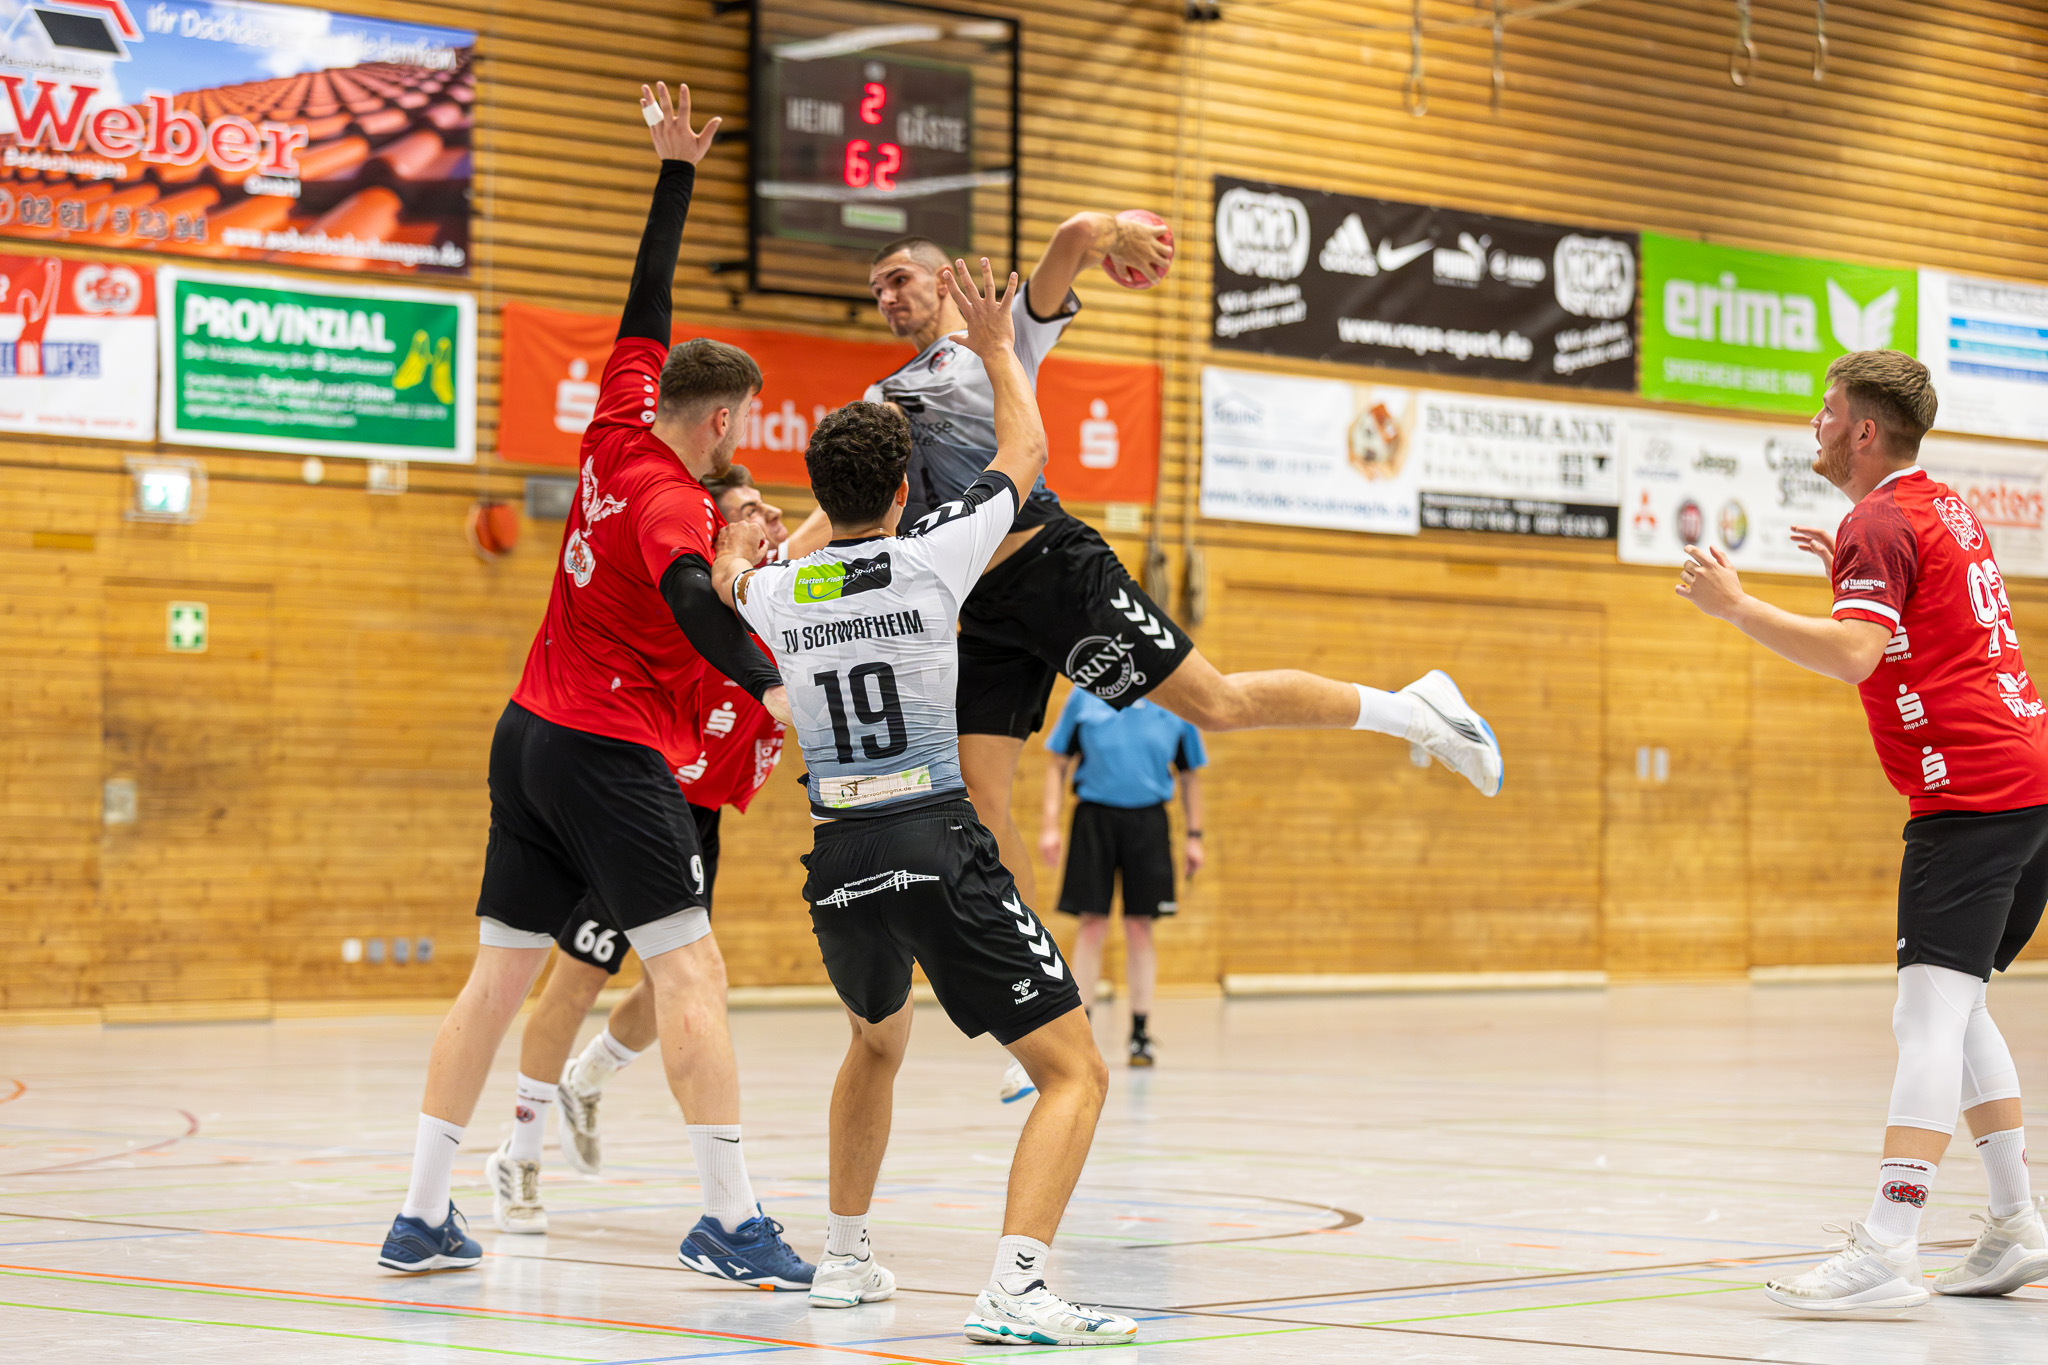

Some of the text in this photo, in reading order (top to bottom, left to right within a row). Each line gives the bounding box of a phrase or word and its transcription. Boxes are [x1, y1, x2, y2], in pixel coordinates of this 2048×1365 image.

[0, 75, 306, 176] Weber
[786, 97, 844, 136] HEIM
[860, 82, 886, 124] 2
[897, 105, 967, 152] GÄSTE
[844, 139, 901, 191] 62
[182, 293, 397, 353] PROVINZIAL
[1662, 271, 1822, 353] erima
[1850, 579, 1886, 589] TEAMSPORT
[782, 609, 925, 655] TV SCHWAFHEIM
[1096, 662, 1131, 696] LIQUEURS
[814, 662, 908, 765] 19
[574, 919, 618, 963] 66
[1014, 989, 1040, 1005] hummel
[1890, 1184, 1926, 1201] HSG
